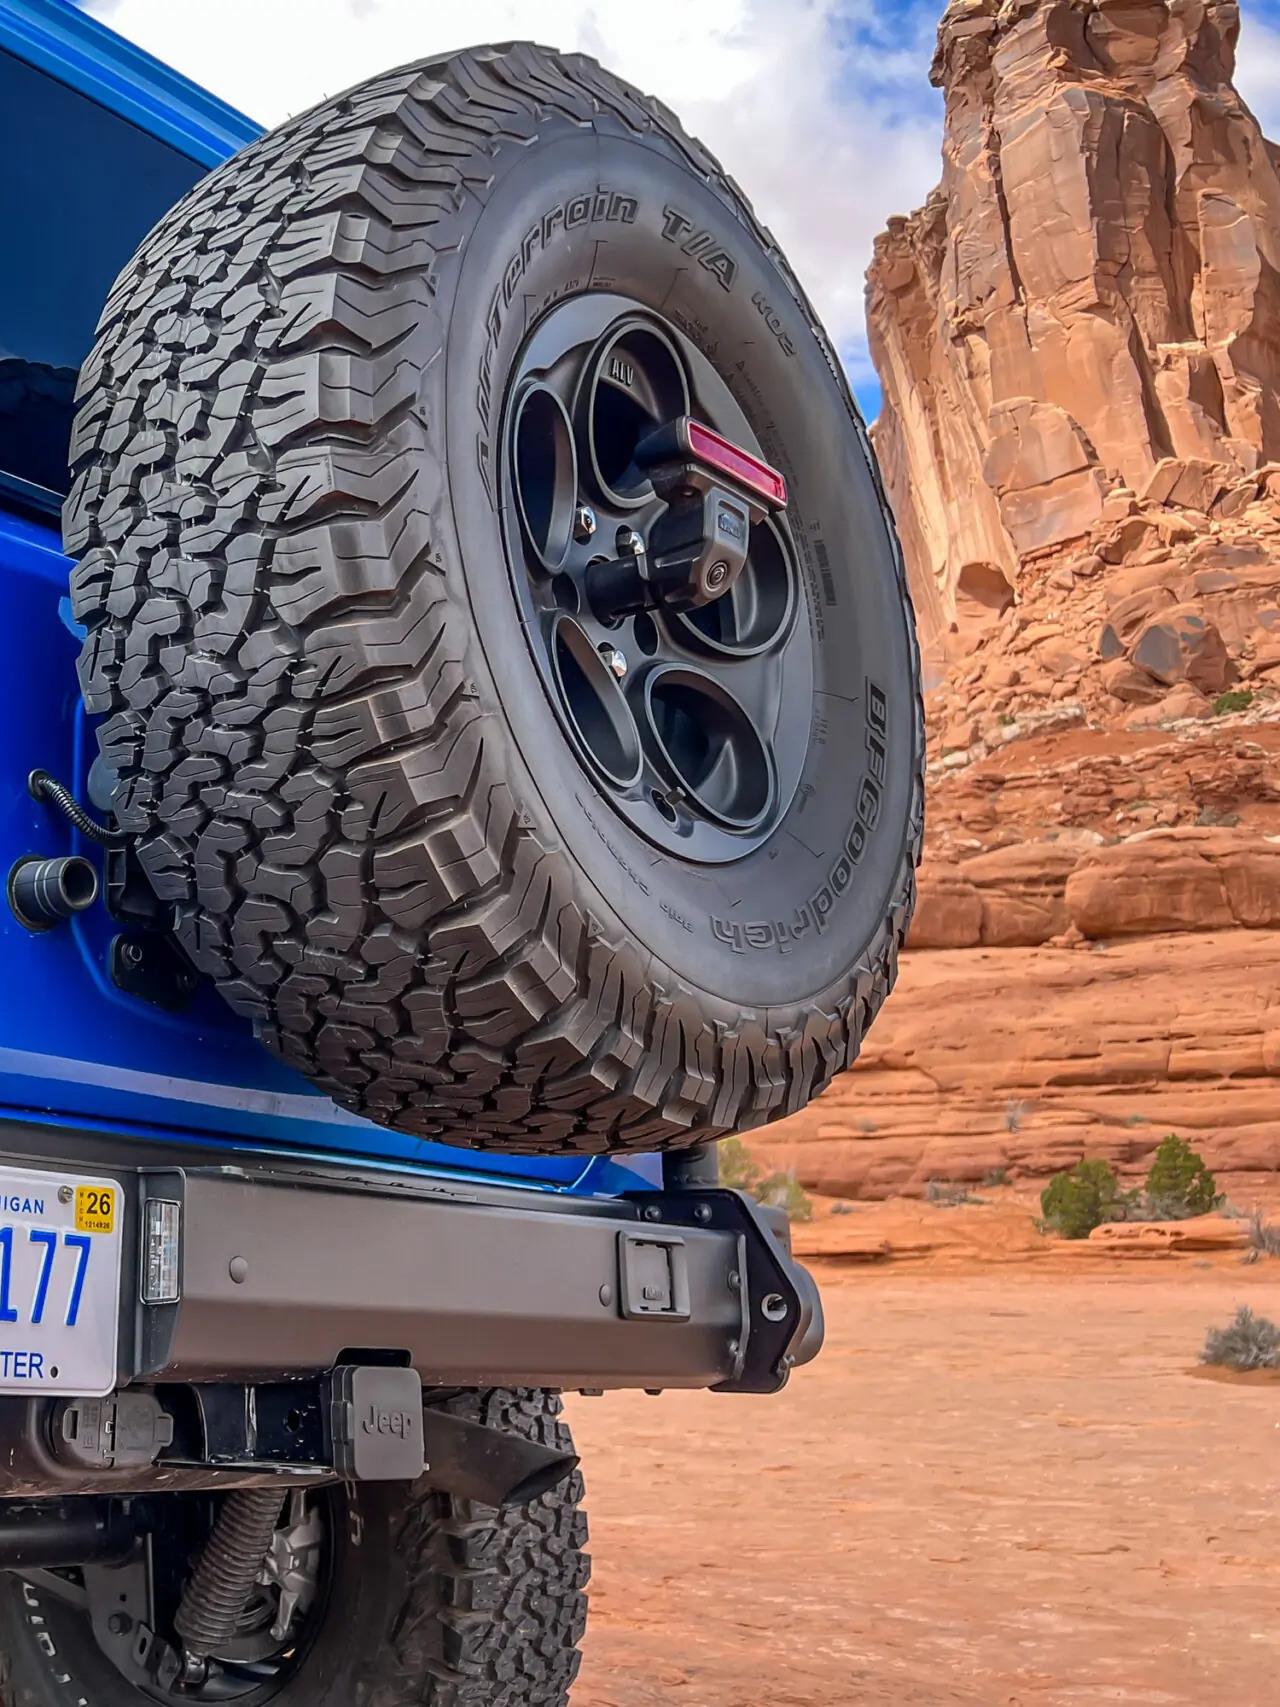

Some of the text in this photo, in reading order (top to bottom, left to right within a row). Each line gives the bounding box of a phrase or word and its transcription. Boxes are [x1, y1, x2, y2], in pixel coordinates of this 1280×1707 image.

[659, 204, 739, 293] T/A
[710, 676, 888, 955] BFGoodrich
[86, 1191, 111, 1216] 26
[362, 1404, 413, 1440] Jeep
